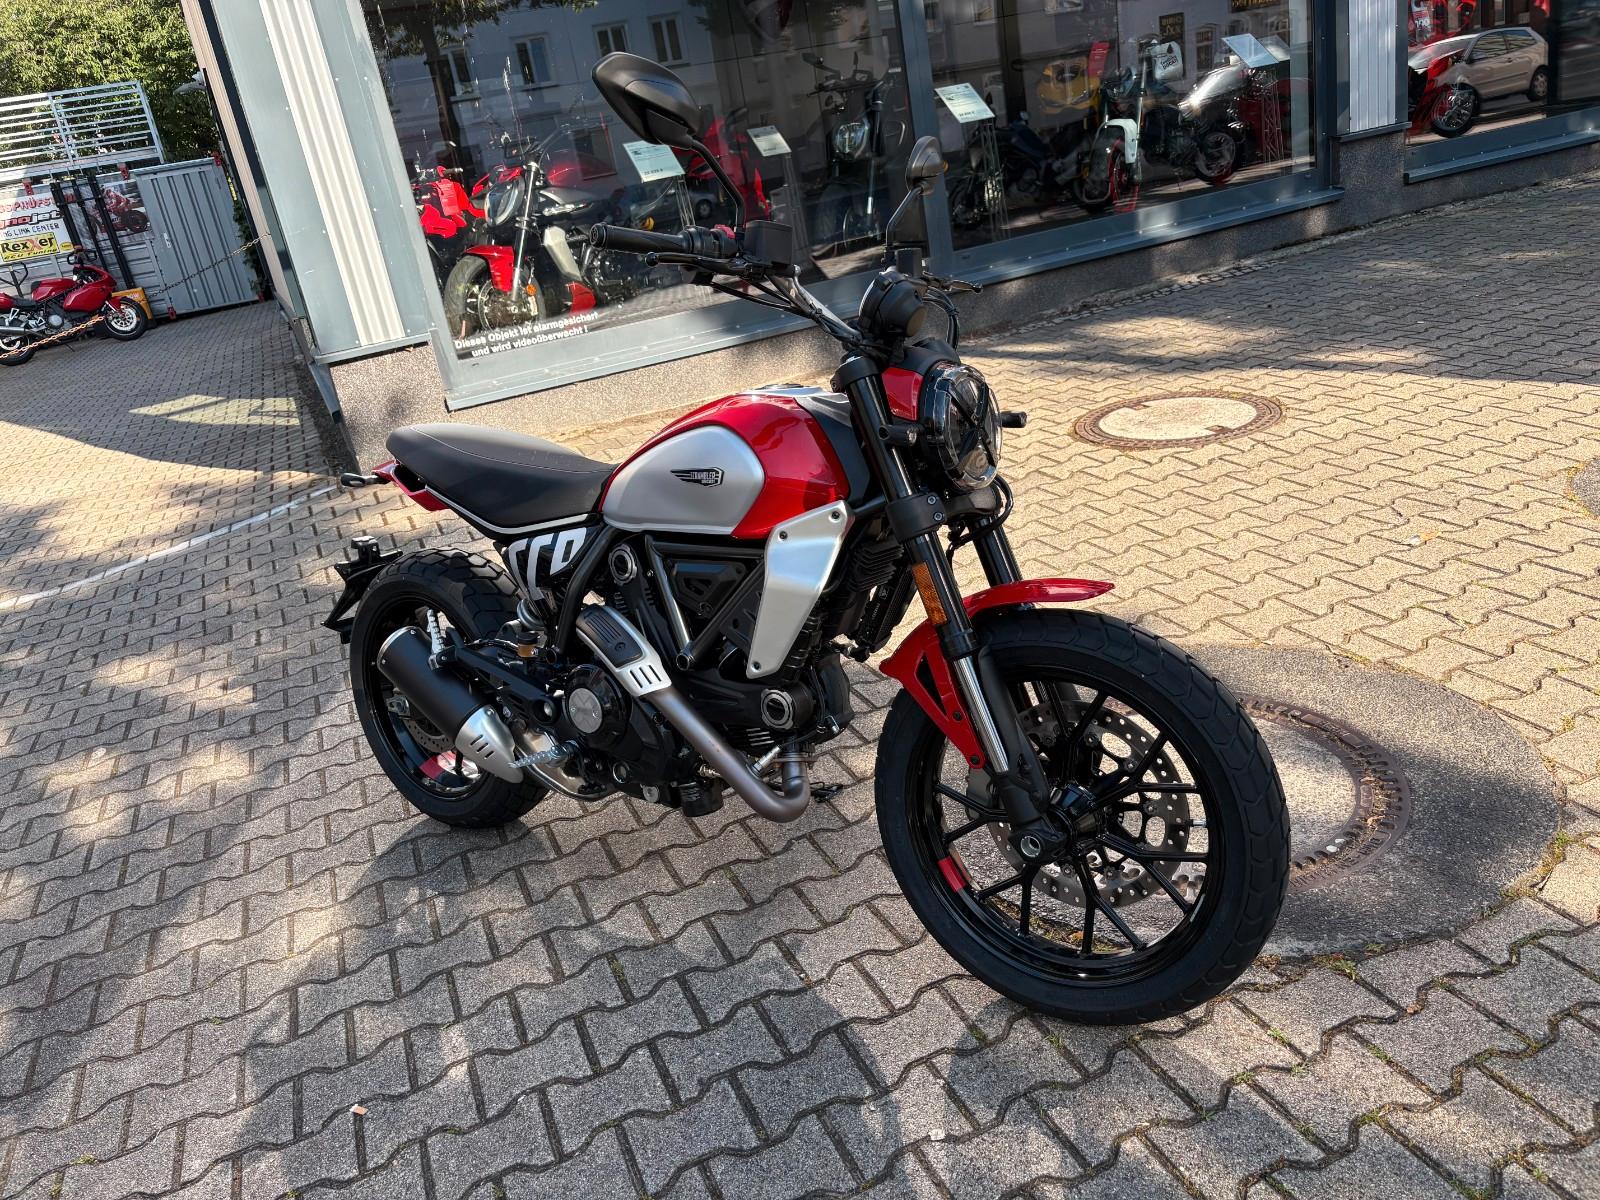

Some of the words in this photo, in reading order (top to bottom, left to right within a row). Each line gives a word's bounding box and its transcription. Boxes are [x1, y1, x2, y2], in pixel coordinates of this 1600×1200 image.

[32, 222, 60, 233] CENTER
[454, 336, 487, 350] Dieses
[487, 329, 519, 343] Objekt
[519, 326, 532, 337] ist
[533, 311, 599, 333] alarmgesichert
[471, 347, 490, 358] und
[491, 342, 511, 353] wird
[513, 327, 584, 349] videoüberwacht
